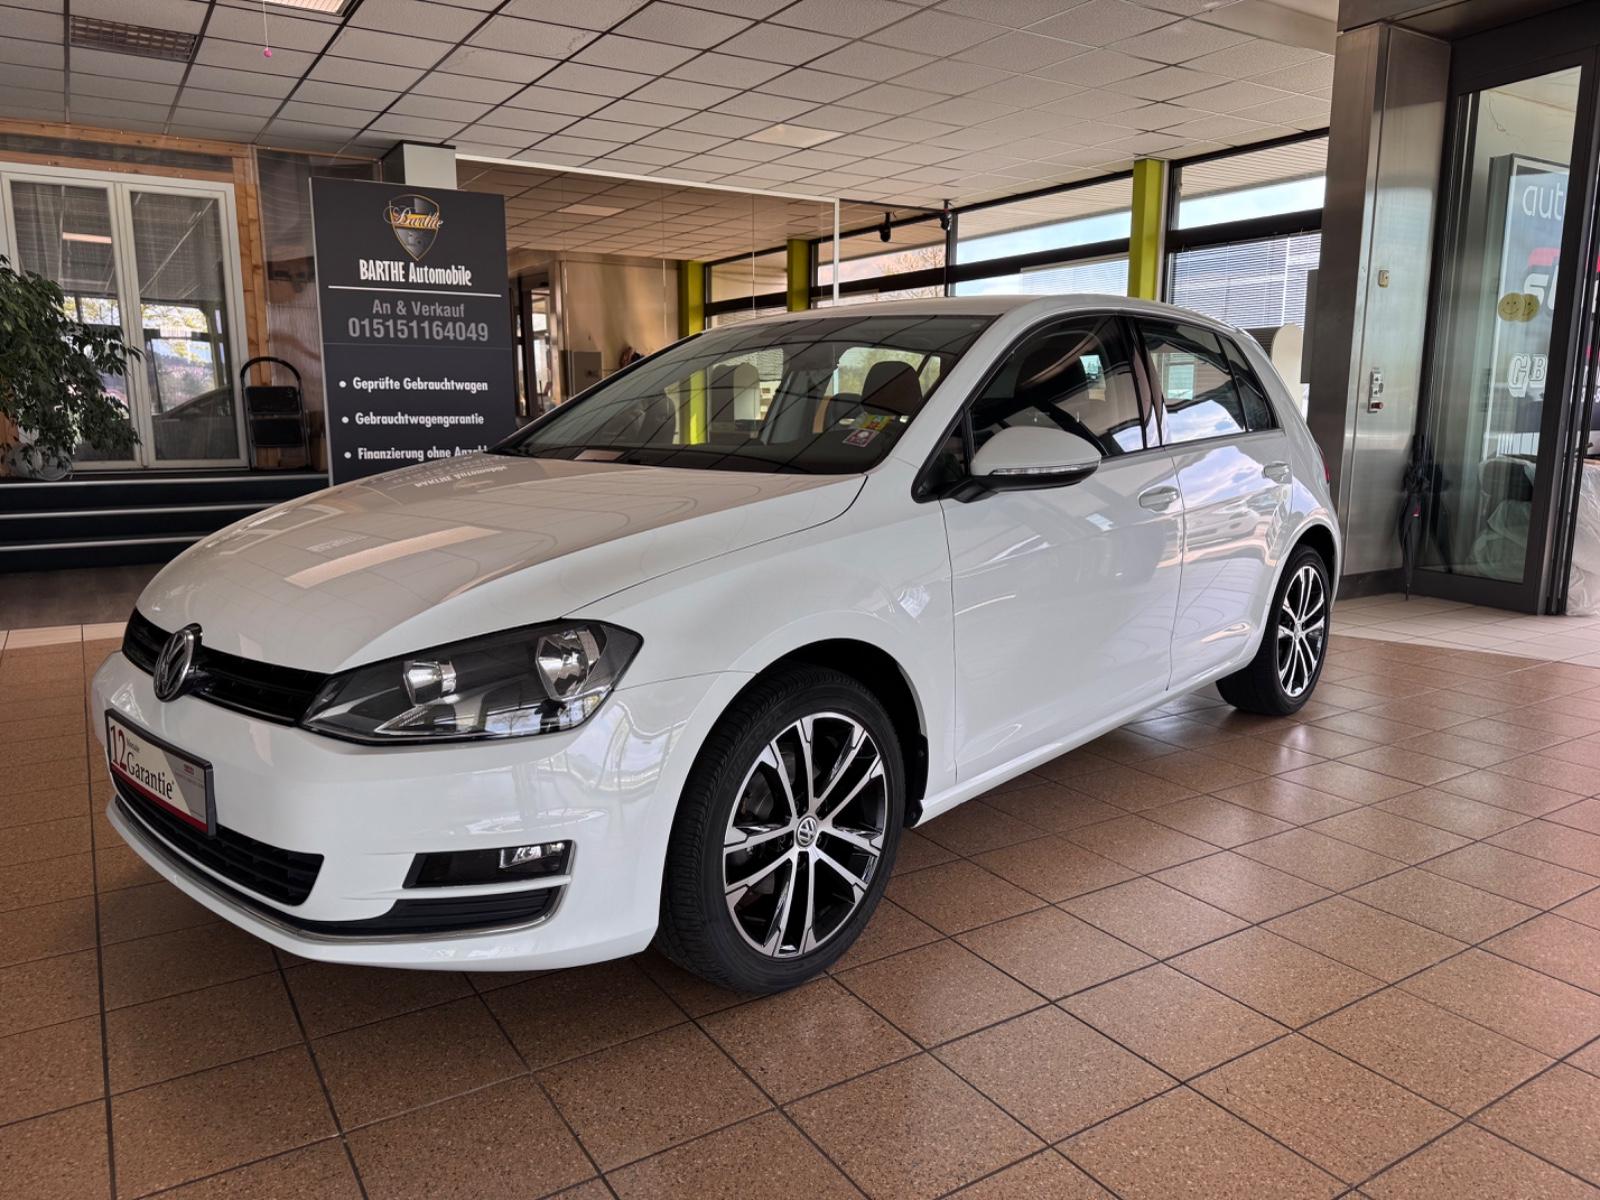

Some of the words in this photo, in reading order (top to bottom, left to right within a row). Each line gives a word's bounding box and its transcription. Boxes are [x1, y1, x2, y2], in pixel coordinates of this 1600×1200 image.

[359, 259, 405, 282] BARTHE
[409, 264, 472, 286] Automobile
[373, 299, 391, 315] An
[396, 300, 407, 315] &
[412, 302, 465, 318] Verkauf
[348, 317, 489, 341] 015151164049
[352, 376, 400, 392] Geprüfte
[403, 377, 488, 394] Gebrauchtwagen
[355, 412, 485, 428] Gebrauchtwagengarantie
[357, 447, 424, 461] Finanzierung
[427, 446, 451, 459] ohne
[110, 725, 127, 772] 12
[127, 752, 174, 800] Garantie
